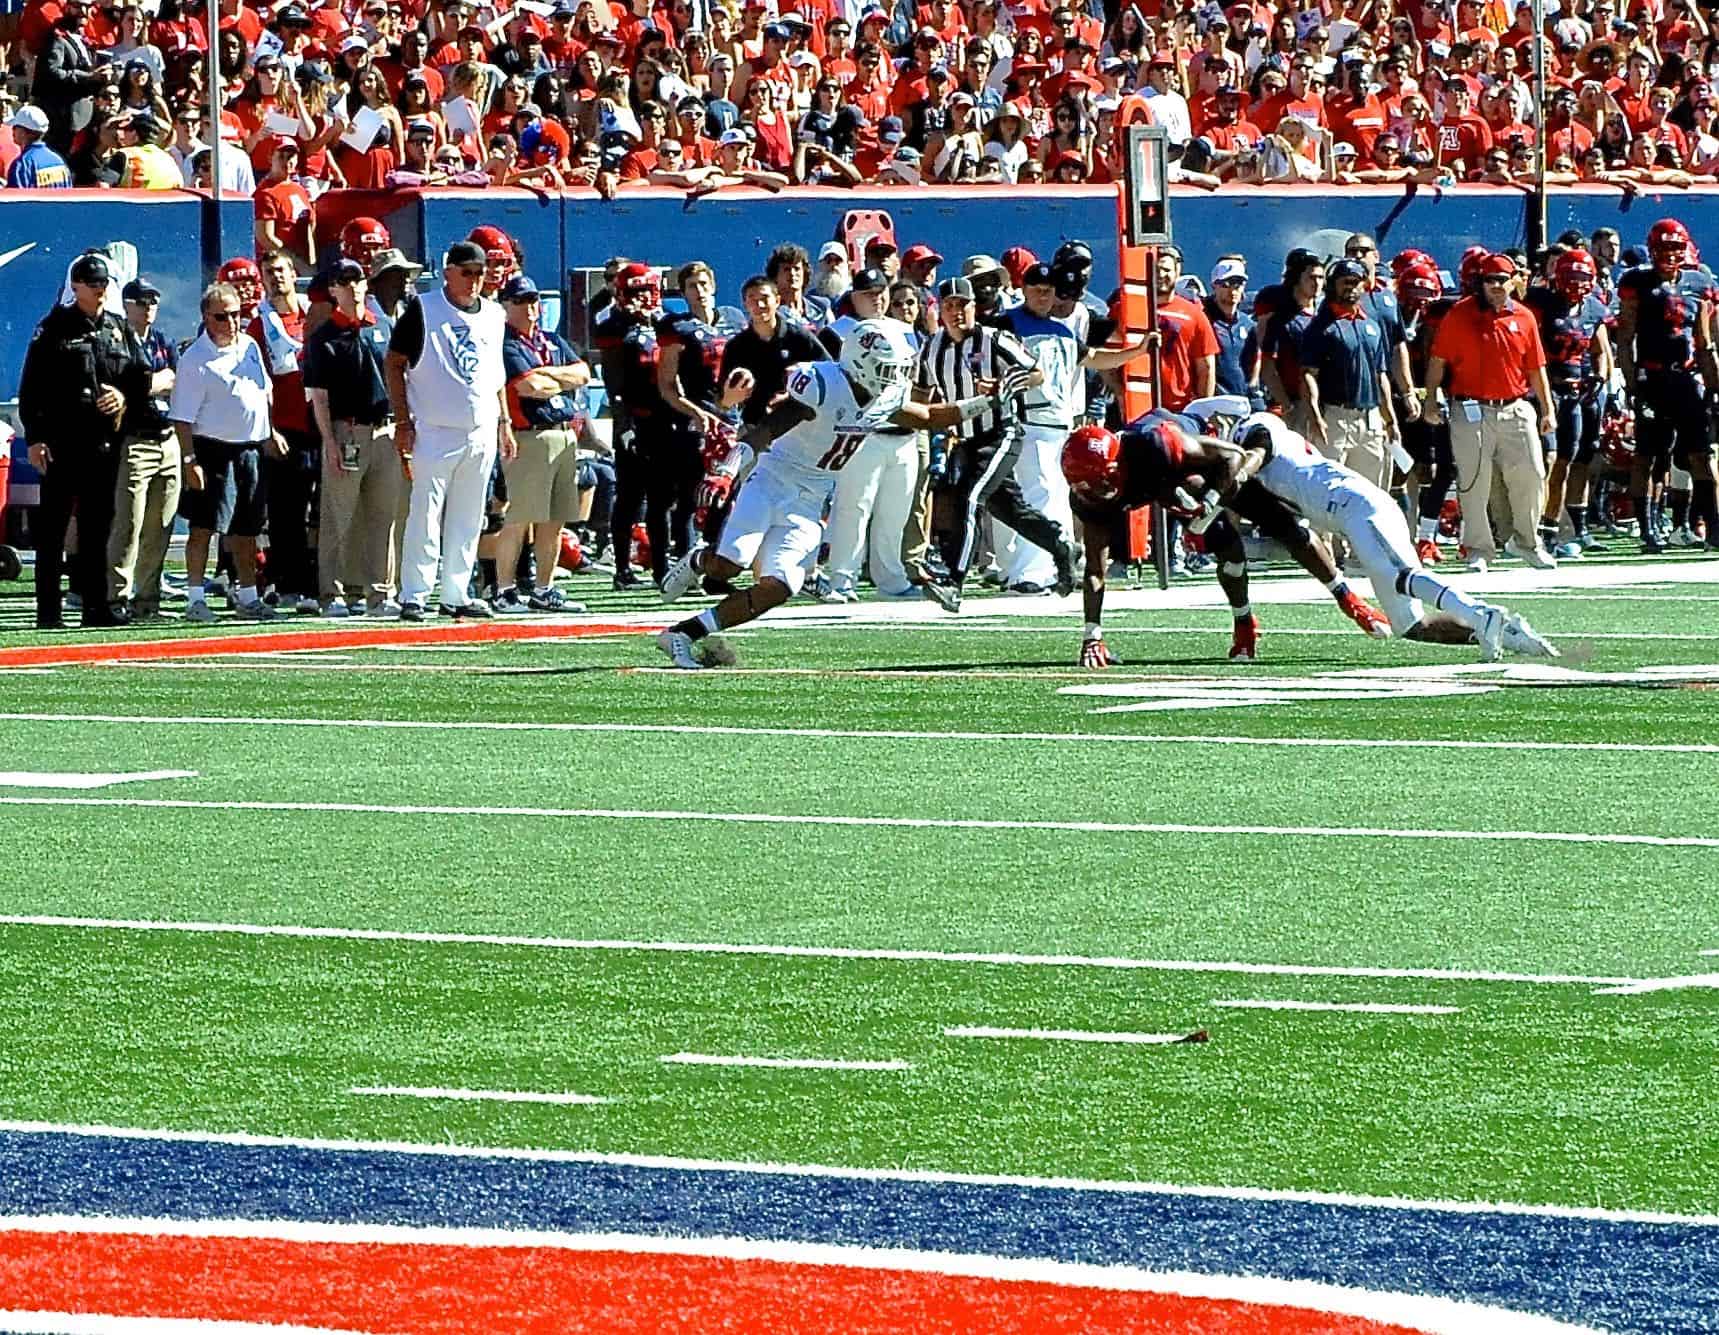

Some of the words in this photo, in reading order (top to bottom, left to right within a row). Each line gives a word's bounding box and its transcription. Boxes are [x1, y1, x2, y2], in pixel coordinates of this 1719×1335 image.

[1440, 126, 1460, 150] A
[1138, 140, 1161, 201] 1
[791, 371, 812, 395] 18
[815, 432, 867, 472] 18
